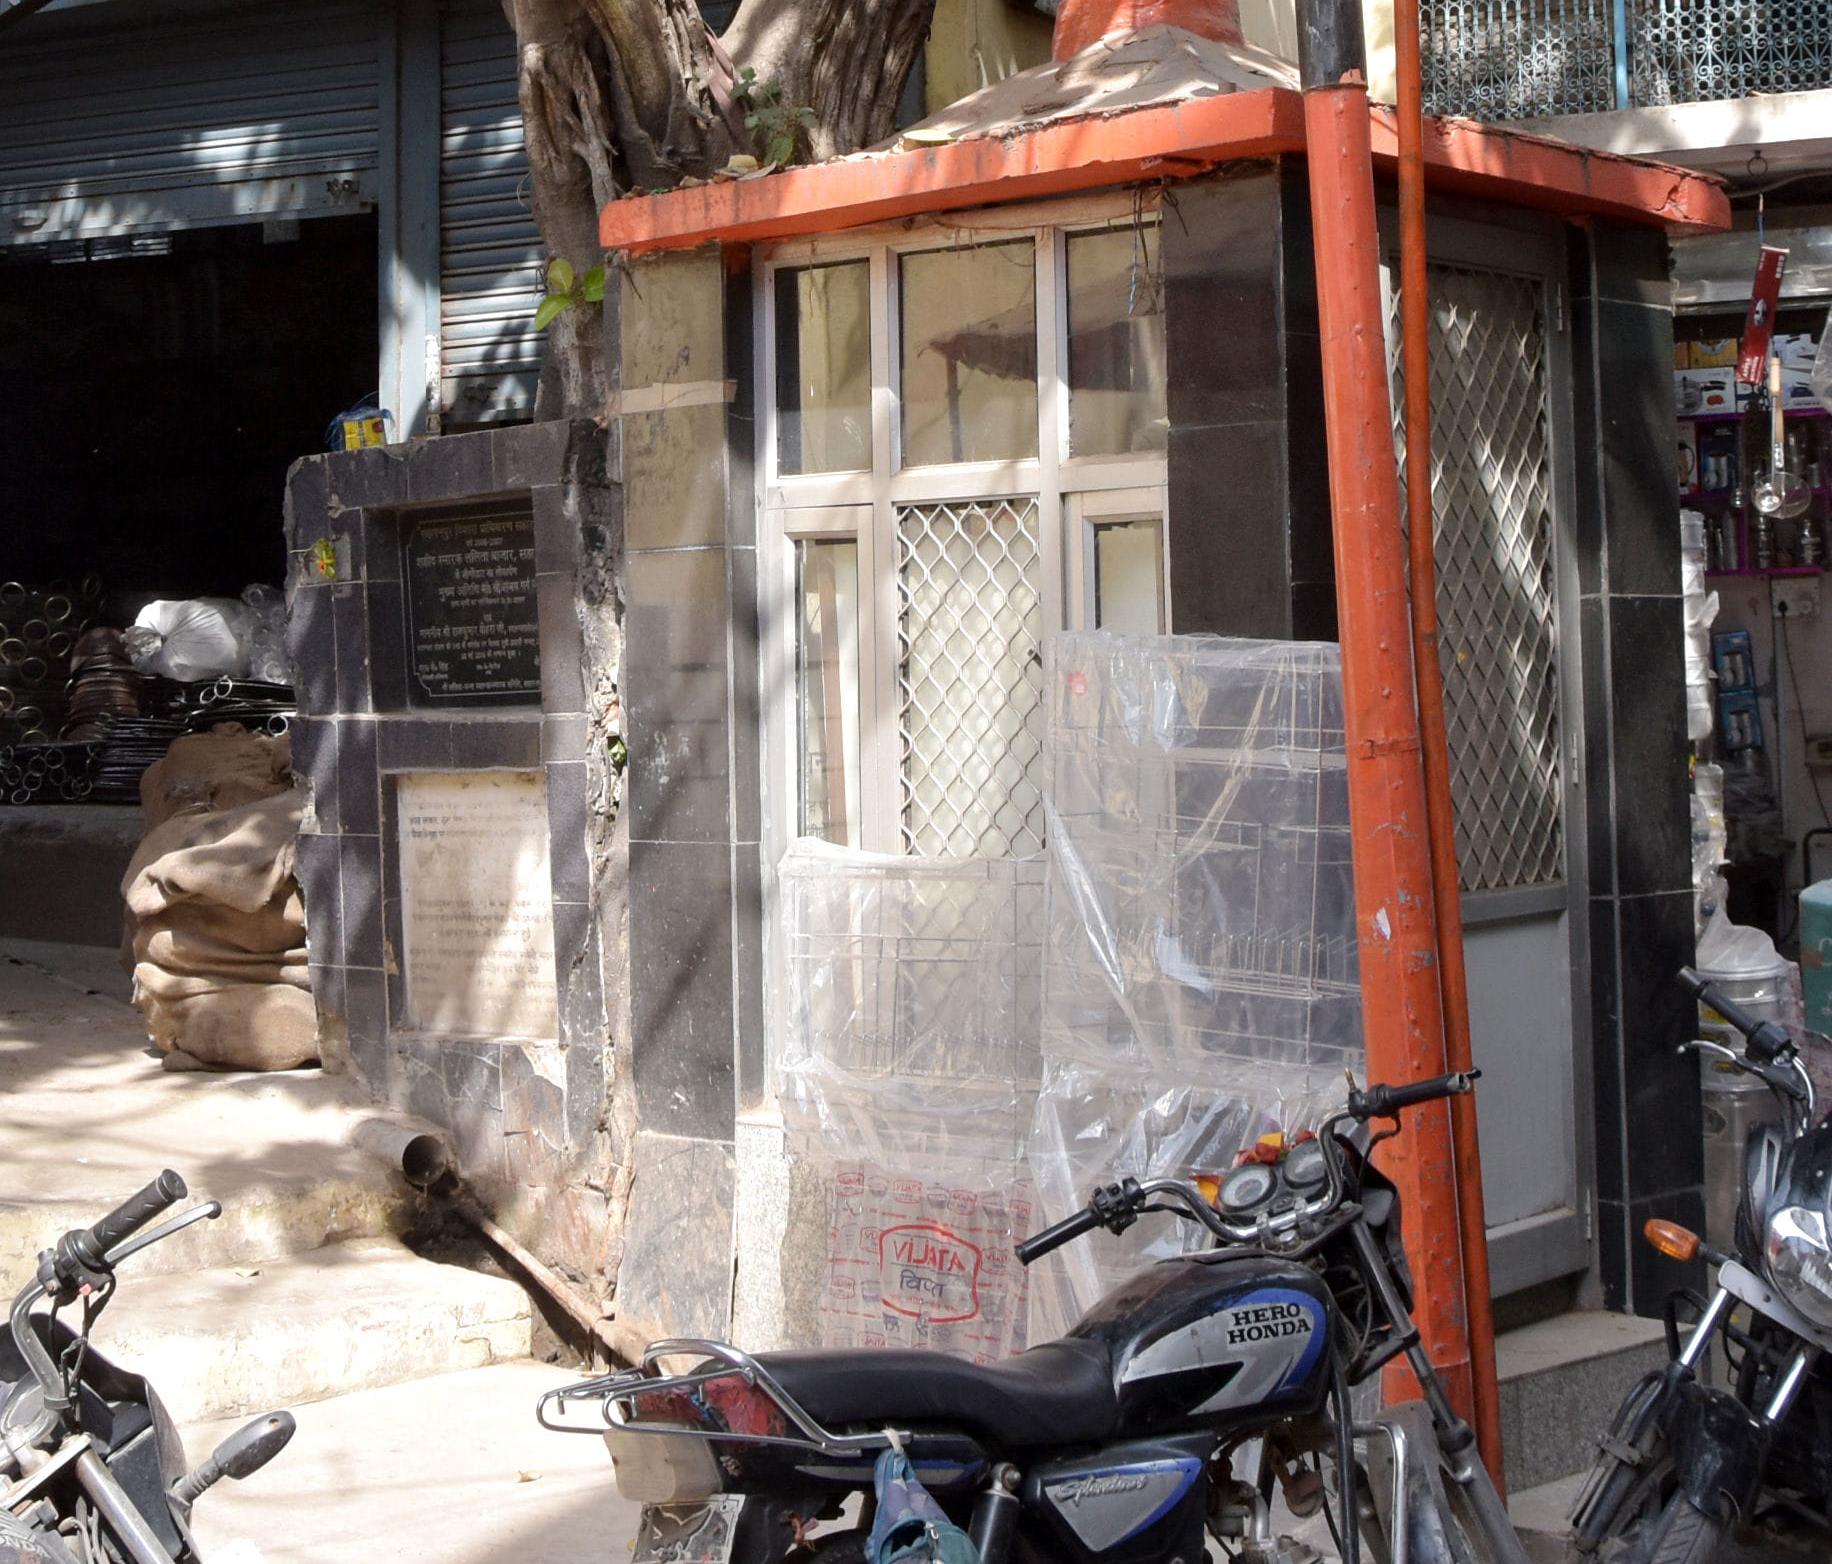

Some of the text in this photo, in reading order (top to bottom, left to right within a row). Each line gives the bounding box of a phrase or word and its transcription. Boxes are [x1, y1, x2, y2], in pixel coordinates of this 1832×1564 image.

[893, 1237, 966, 1272] VIJATA
[1232, 1302, 1301, 1327] HERO
[1227, 1318, 1312, 1345] HONDA
